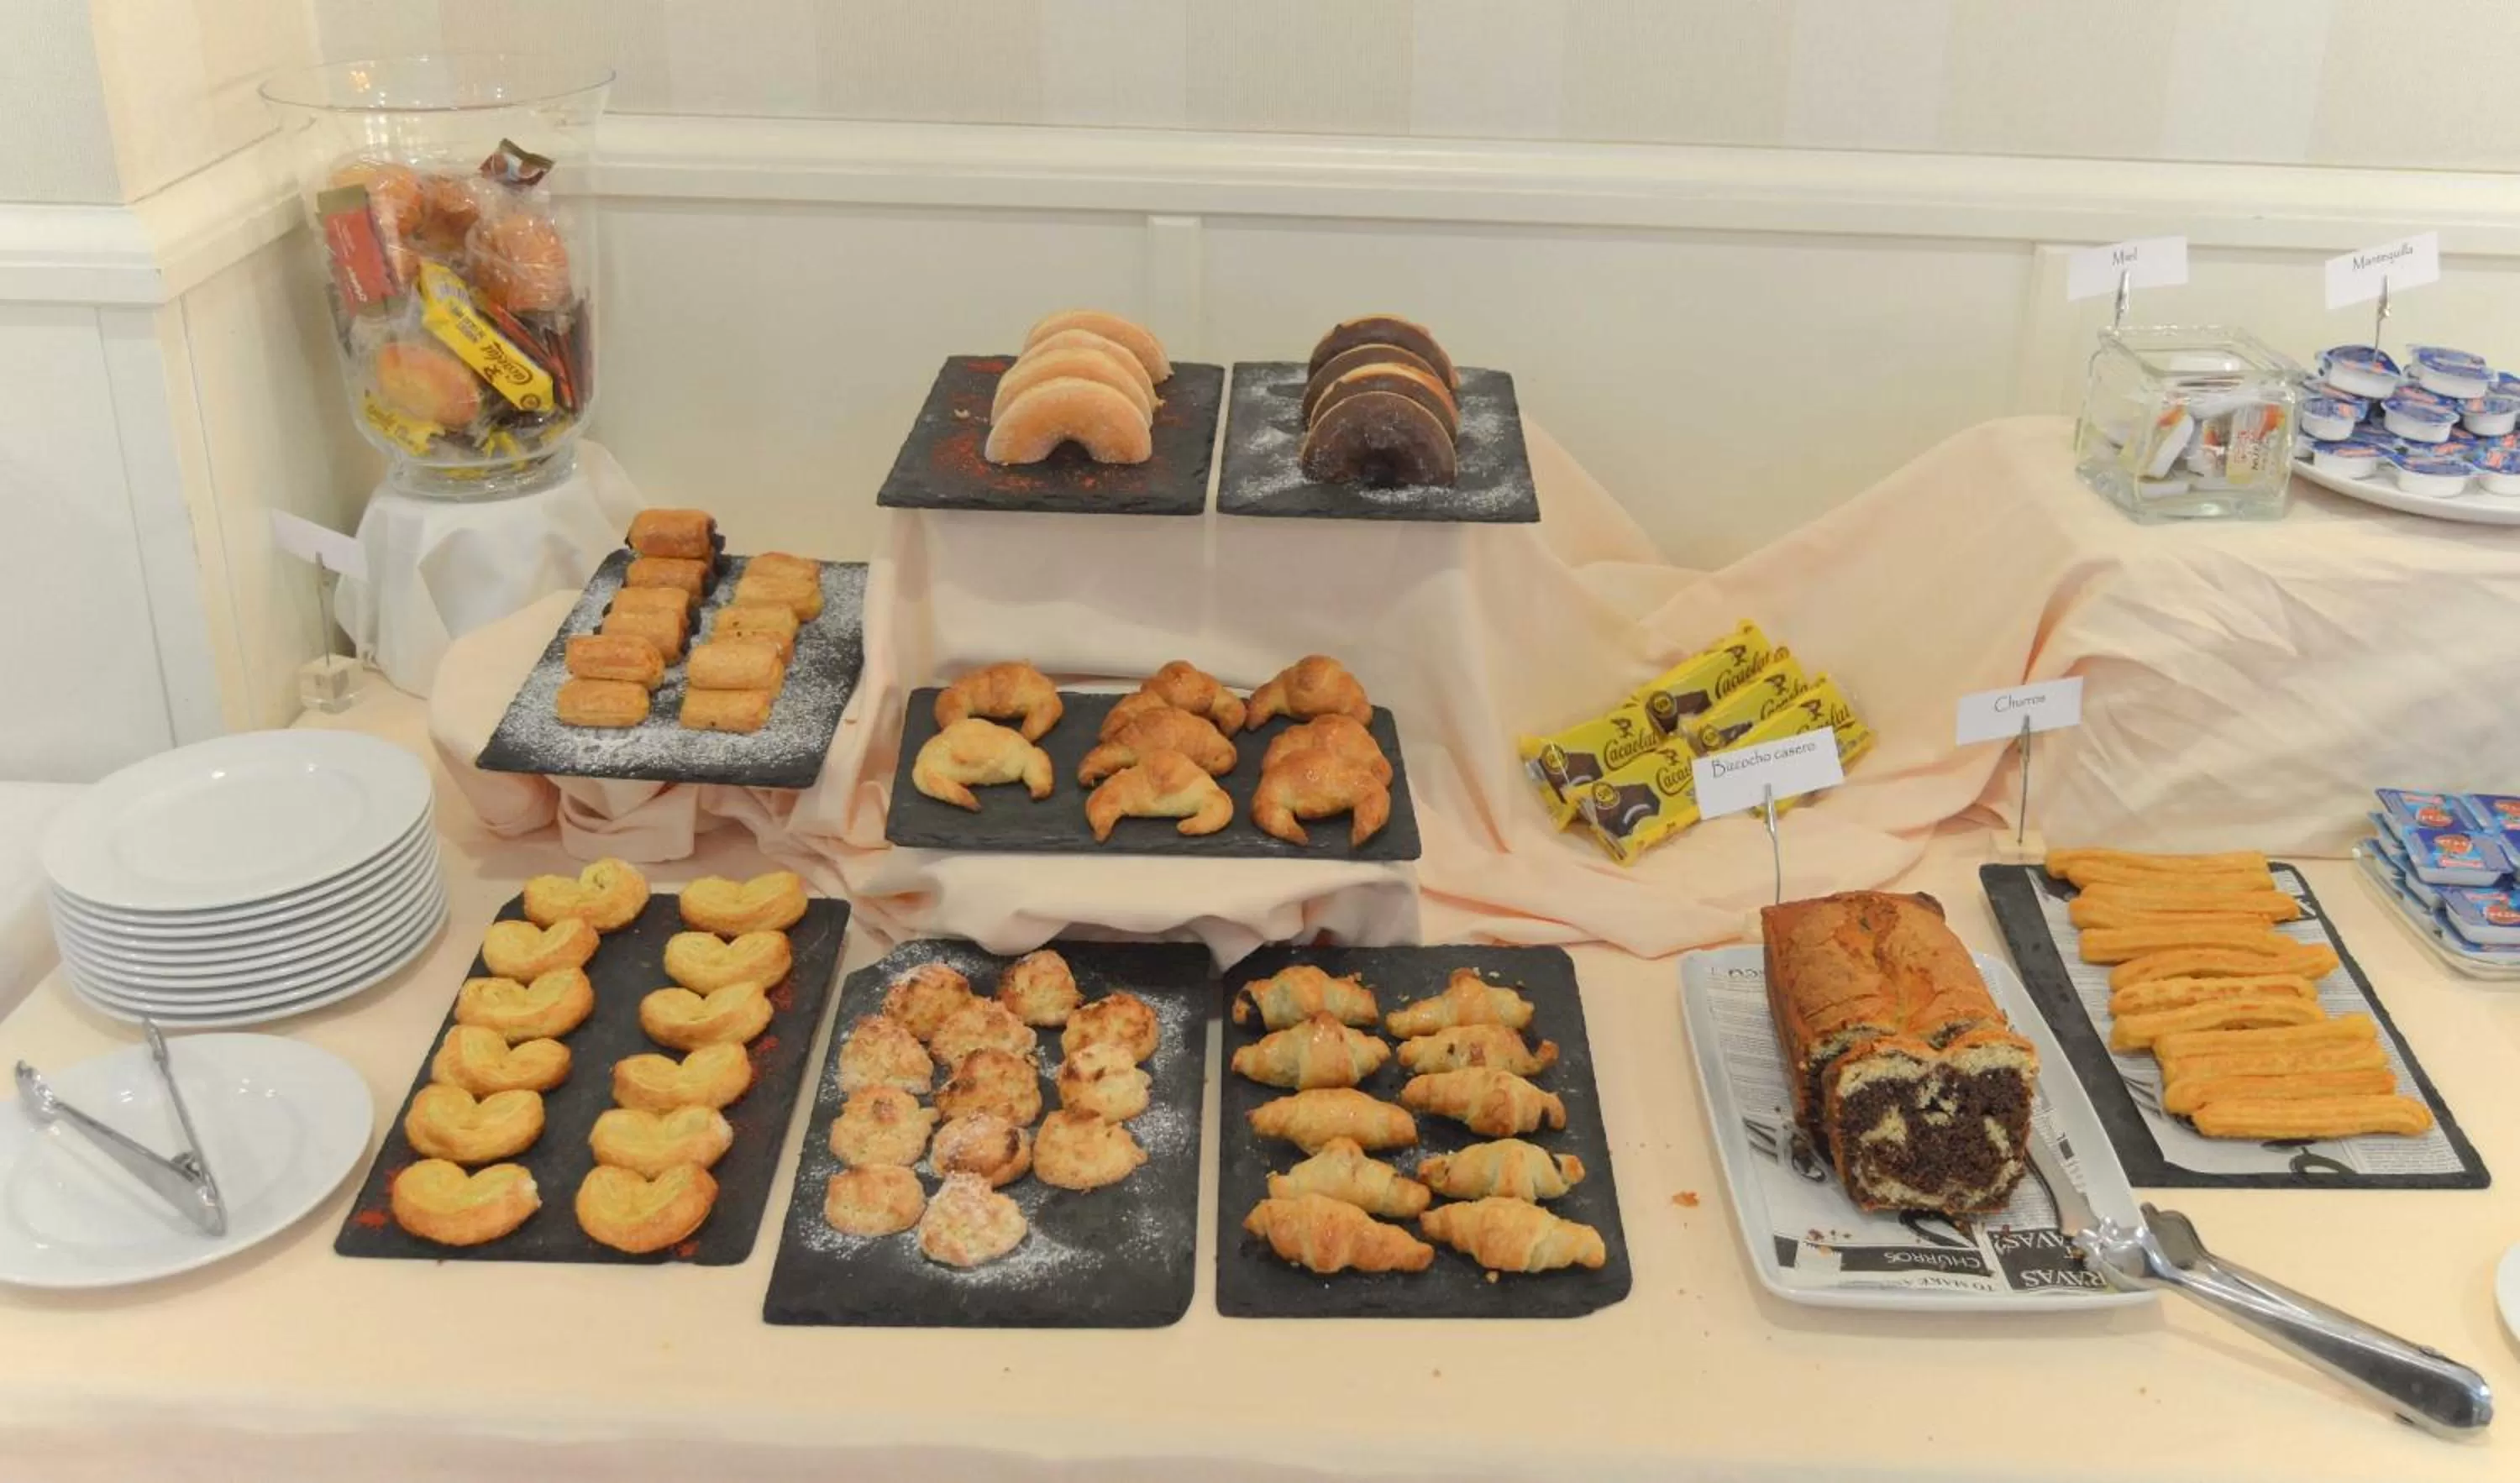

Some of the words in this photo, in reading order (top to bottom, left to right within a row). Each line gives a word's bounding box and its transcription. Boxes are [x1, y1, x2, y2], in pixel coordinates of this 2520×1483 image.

[2112, 246, 2138, 266] Miel
[2353, 243, 2413, 269] Mantequilla
[1714, 650, 1771, 700] Cacaolat
[1994, 694, 2046, 713] Churros
[1604, 726, 1659, 772] Cacaolat
[1711, 749, 1772, 779] Bizcocho
[1774, 742, 1816, 760] casero
[1882, 1250, 1982, 1269] CHURROS
[2020, 1269, 2108, 1288] RAVAS
